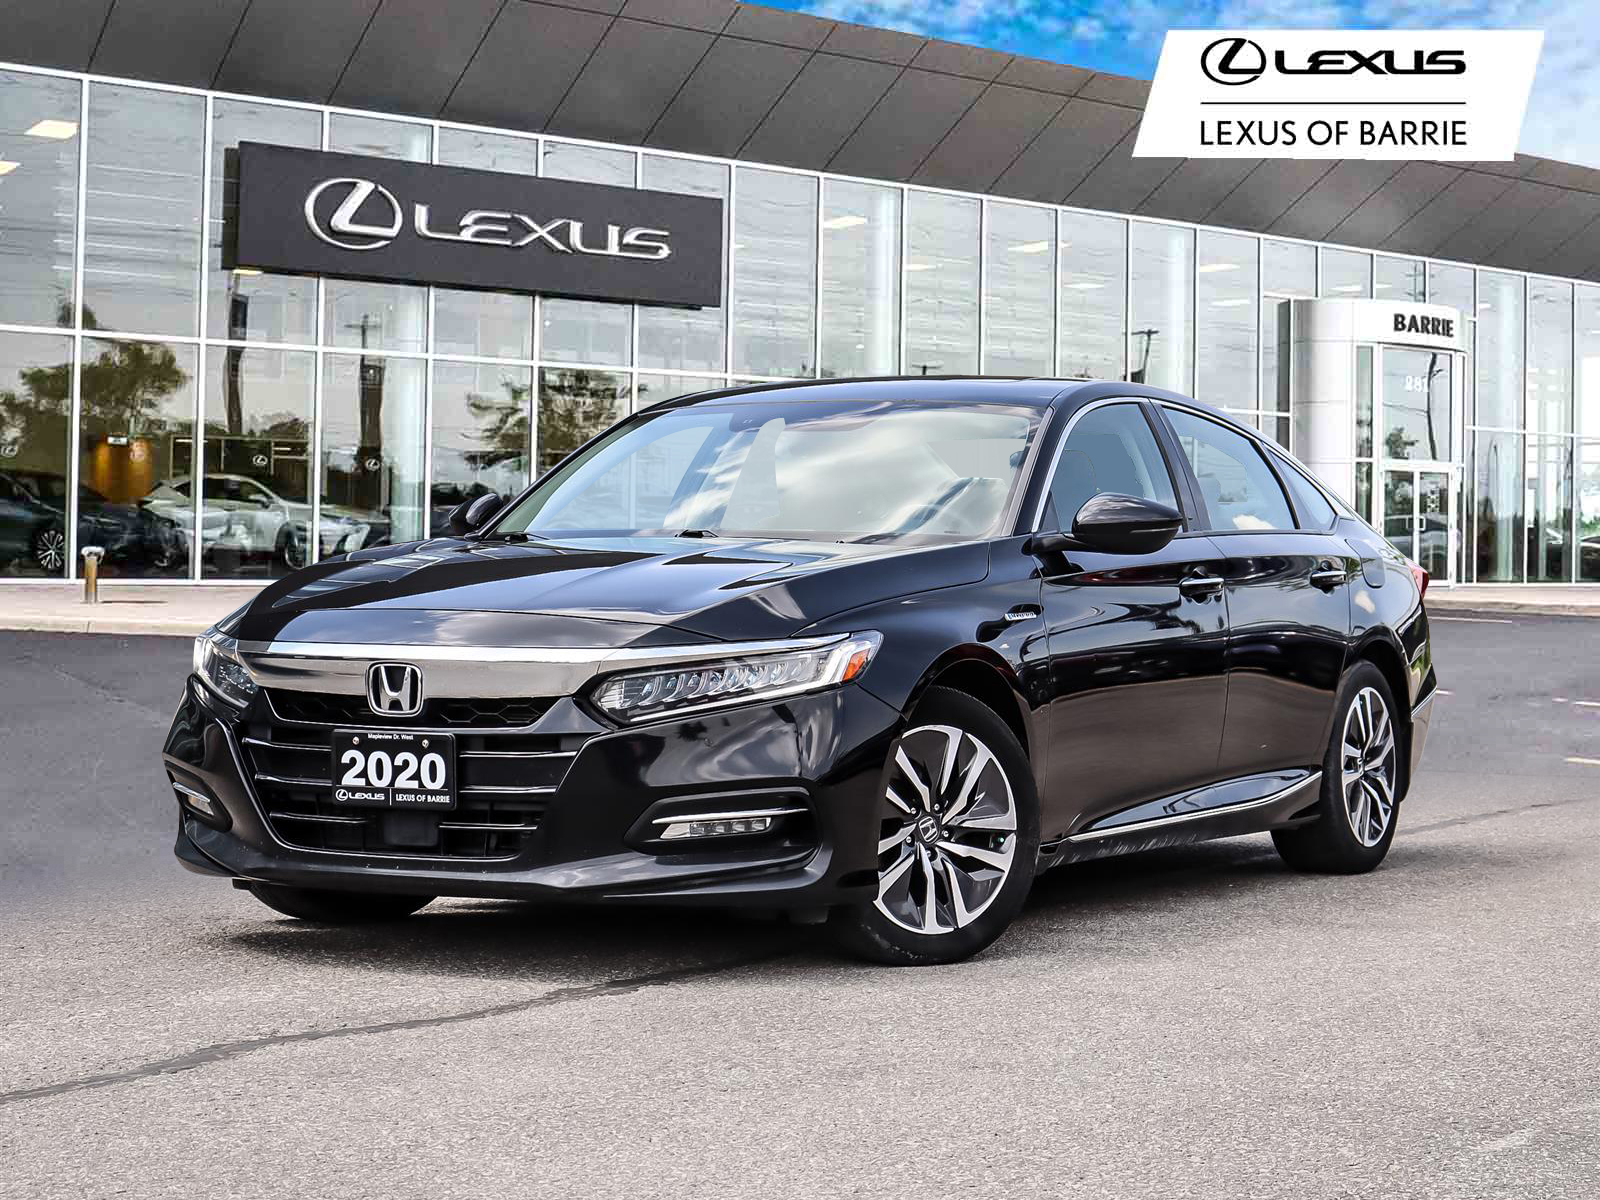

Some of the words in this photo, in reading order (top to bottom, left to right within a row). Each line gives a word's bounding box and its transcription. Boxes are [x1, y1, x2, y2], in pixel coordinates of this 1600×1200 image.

[414, 204, 671, 261] LEXUS
[1393, 313, 1455, 338] BARRIE
[341, 749, 446, 790] 2020
[348, 792, 385, 801] LEXUS
[396, 793, 416, 802] LEXUS
[427, 795, 450, 803] BARRIE
